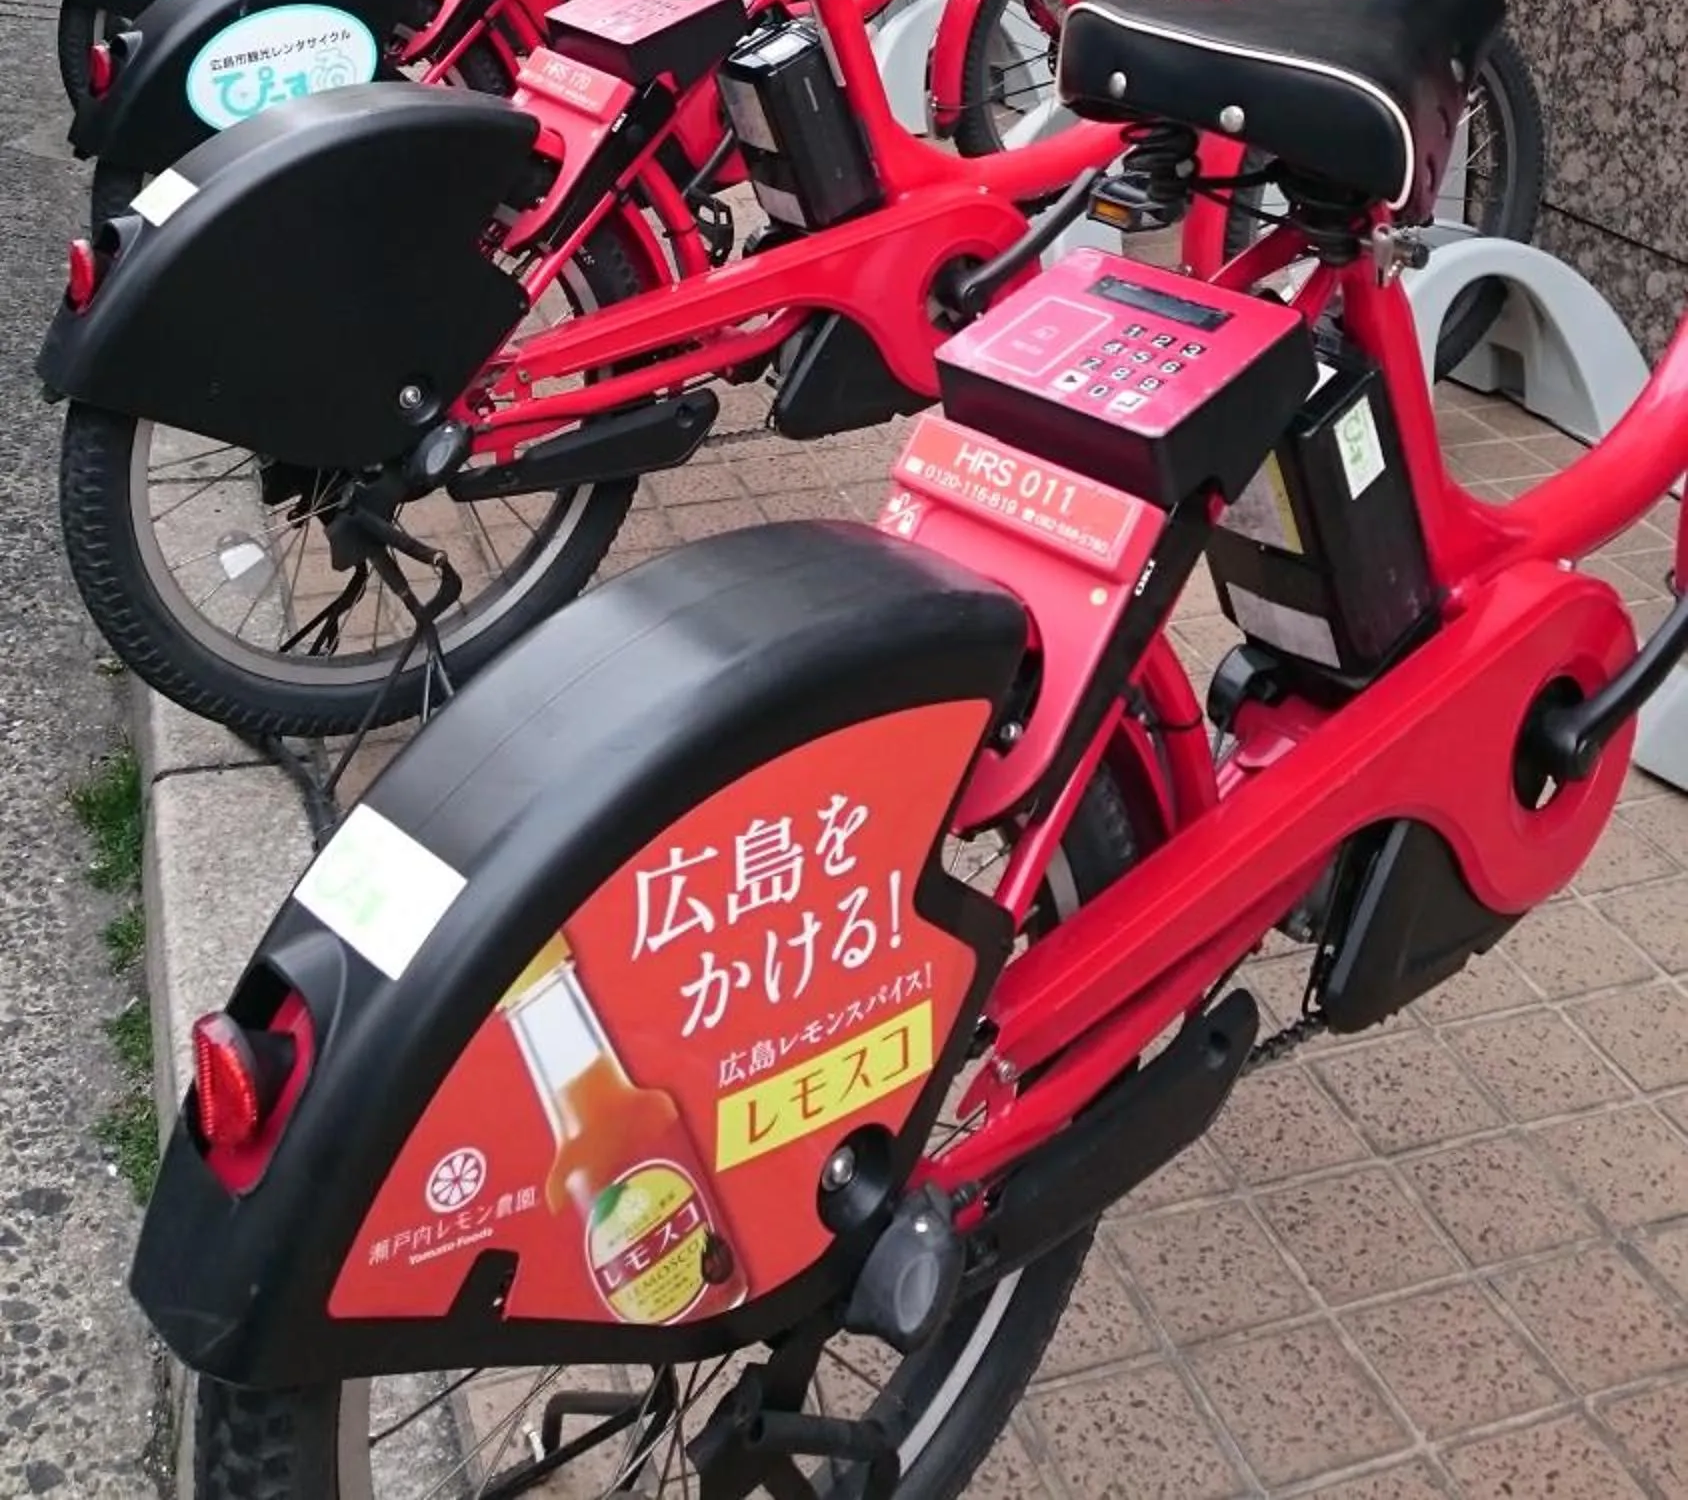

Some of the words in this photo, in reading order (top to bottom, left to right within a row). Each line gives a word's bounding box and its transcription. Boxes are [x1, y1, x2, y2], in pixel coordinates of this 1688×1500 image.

[209, 28, 352, 72] 広島市観光レンタサイクル
[954, 441, 1017, 487] HRS
[1018, 469, 1077, 516] 011
[1134, 559, 1156, 596] OKI
[631, 794, 869, 962] 広島を
[747, 1026, 909, 1145] レモスコ
[602, 1201, 700, 1289] レモスコ
